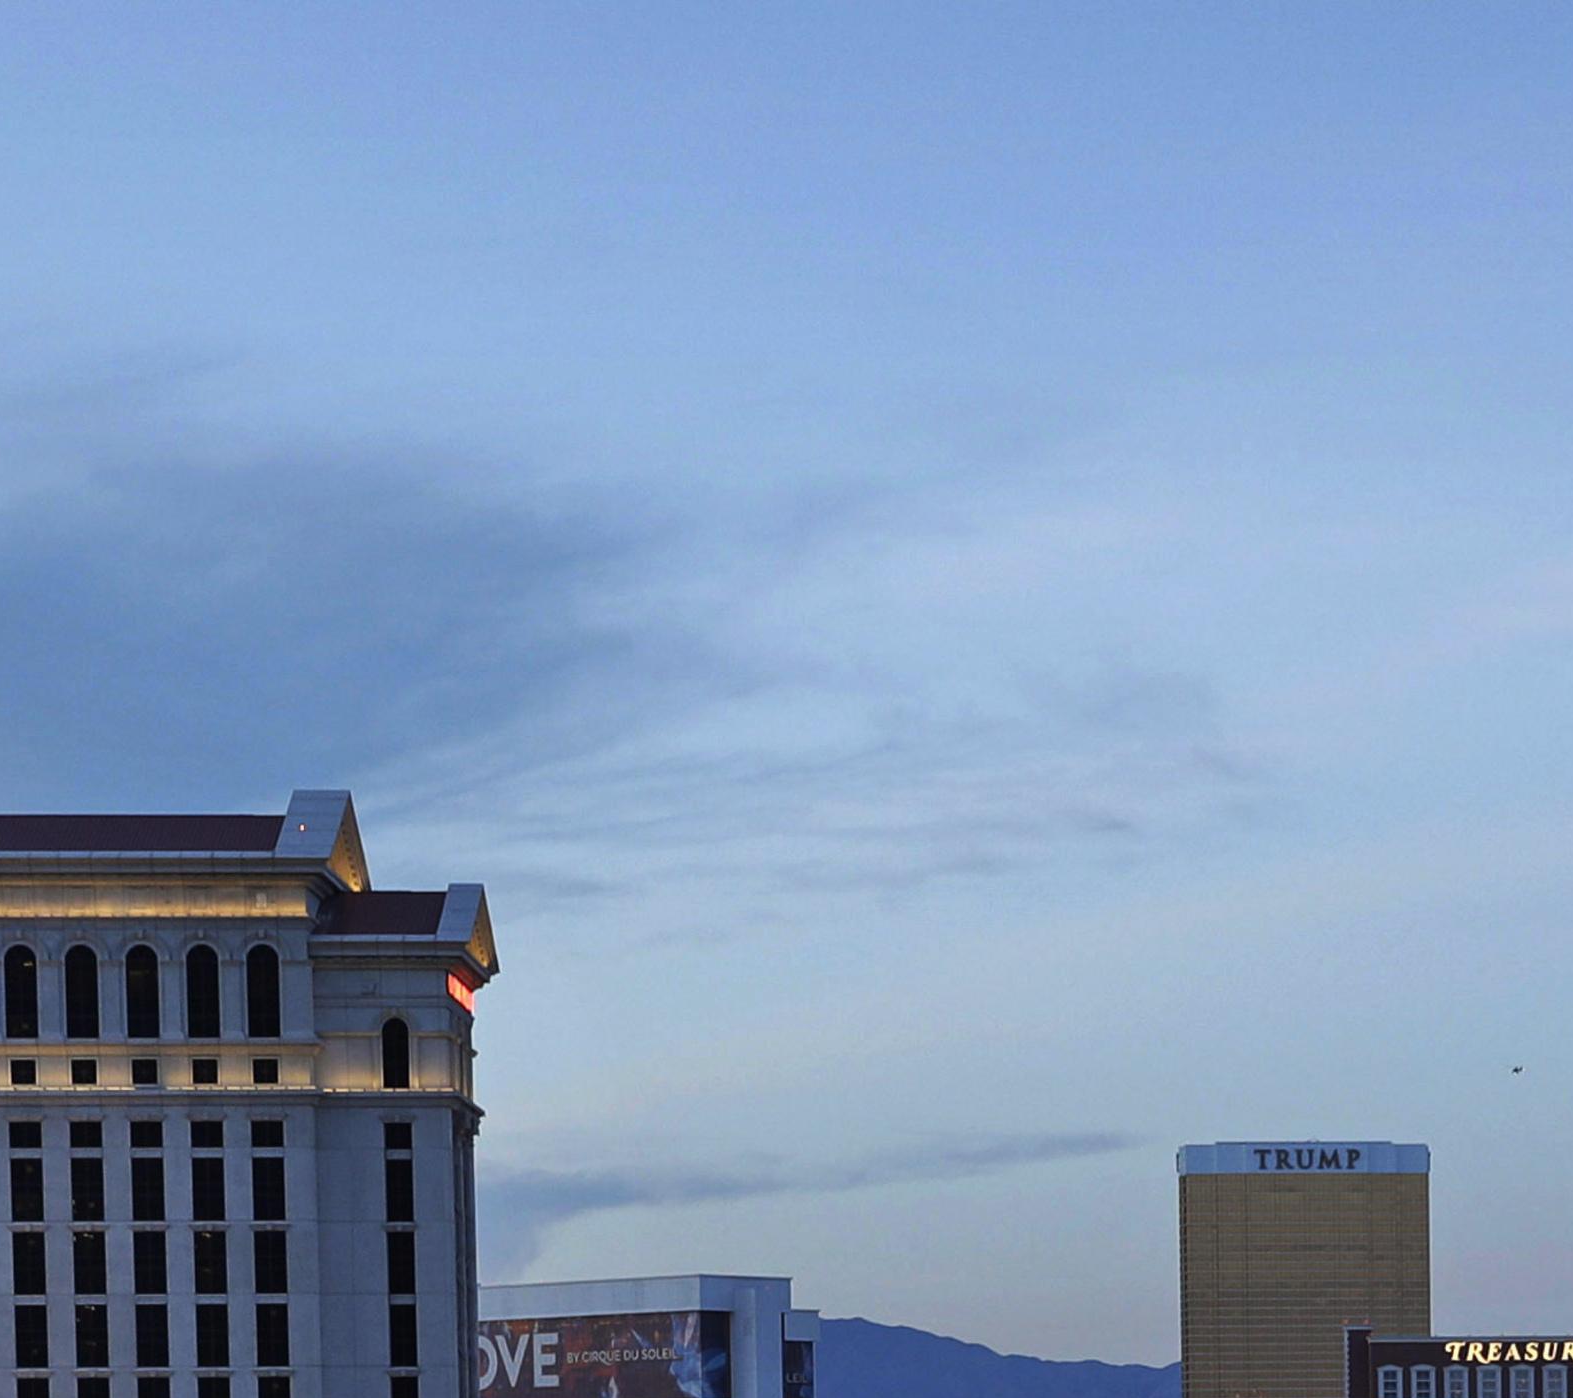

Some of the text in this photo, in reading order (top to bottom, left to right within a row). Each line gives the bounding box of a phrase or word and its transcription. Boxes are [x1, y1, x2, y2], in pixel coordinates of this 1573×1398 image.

[1253, 1148, 1361, 1170] TRUMP
[566, 1351, 580, 1364] BY
[581, 1350, 621, 1366] CIRQUE
[623, 1348, 639, 1362] DU
[641, 1347, 678, 1361] SOLEIL
